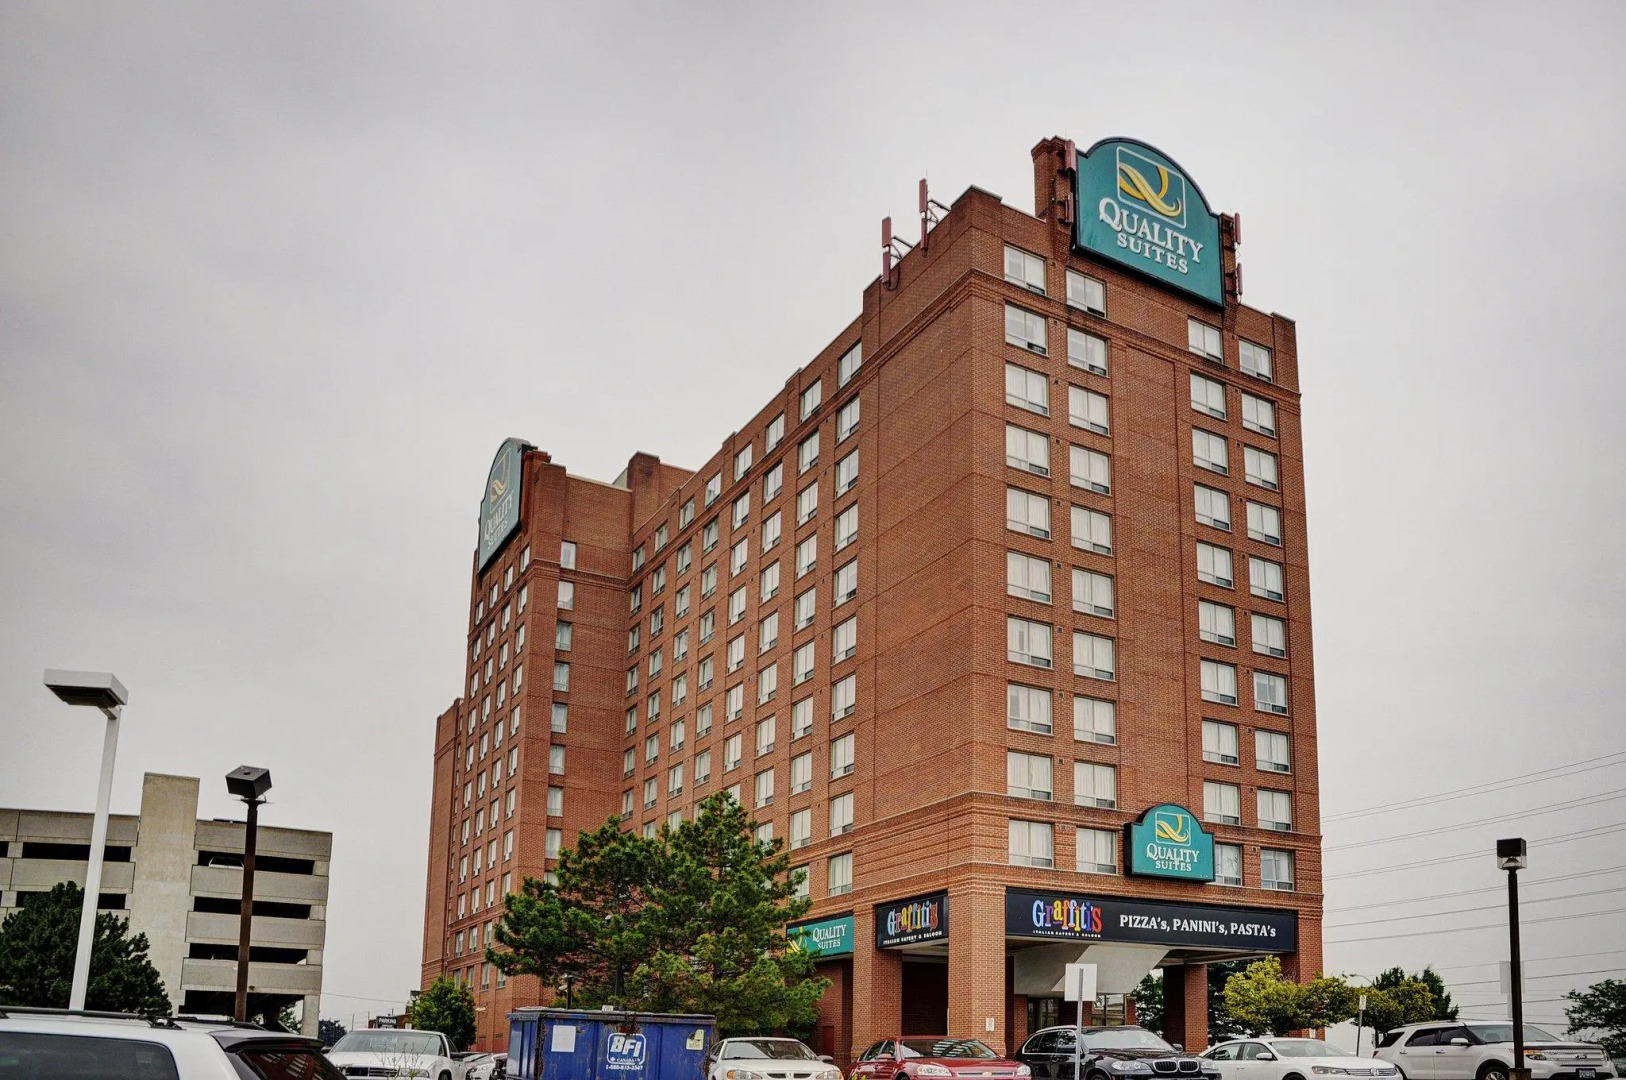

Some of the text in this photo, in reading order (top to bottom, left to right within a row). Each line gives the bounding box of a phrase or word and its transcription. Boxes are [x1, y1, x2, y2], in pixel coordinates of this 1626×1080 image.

[1099, 198, 1203, 264] QUALITY
[1117, 233, 1188, 275] SUITES
[1147, 843, 1199, 862] QUALITY
[1155, 860, 1192, 872] SUITES
[1032, 899, 1103, 933] Graffiti's
[1119, 914, 1276, 938] PIZZA's, PANINI's, PASTA's
[813, 924, 846, 942] QUALITY
[818, 938, 841, 949] SUITES
[610, 1035, 642, 1057] BFI
